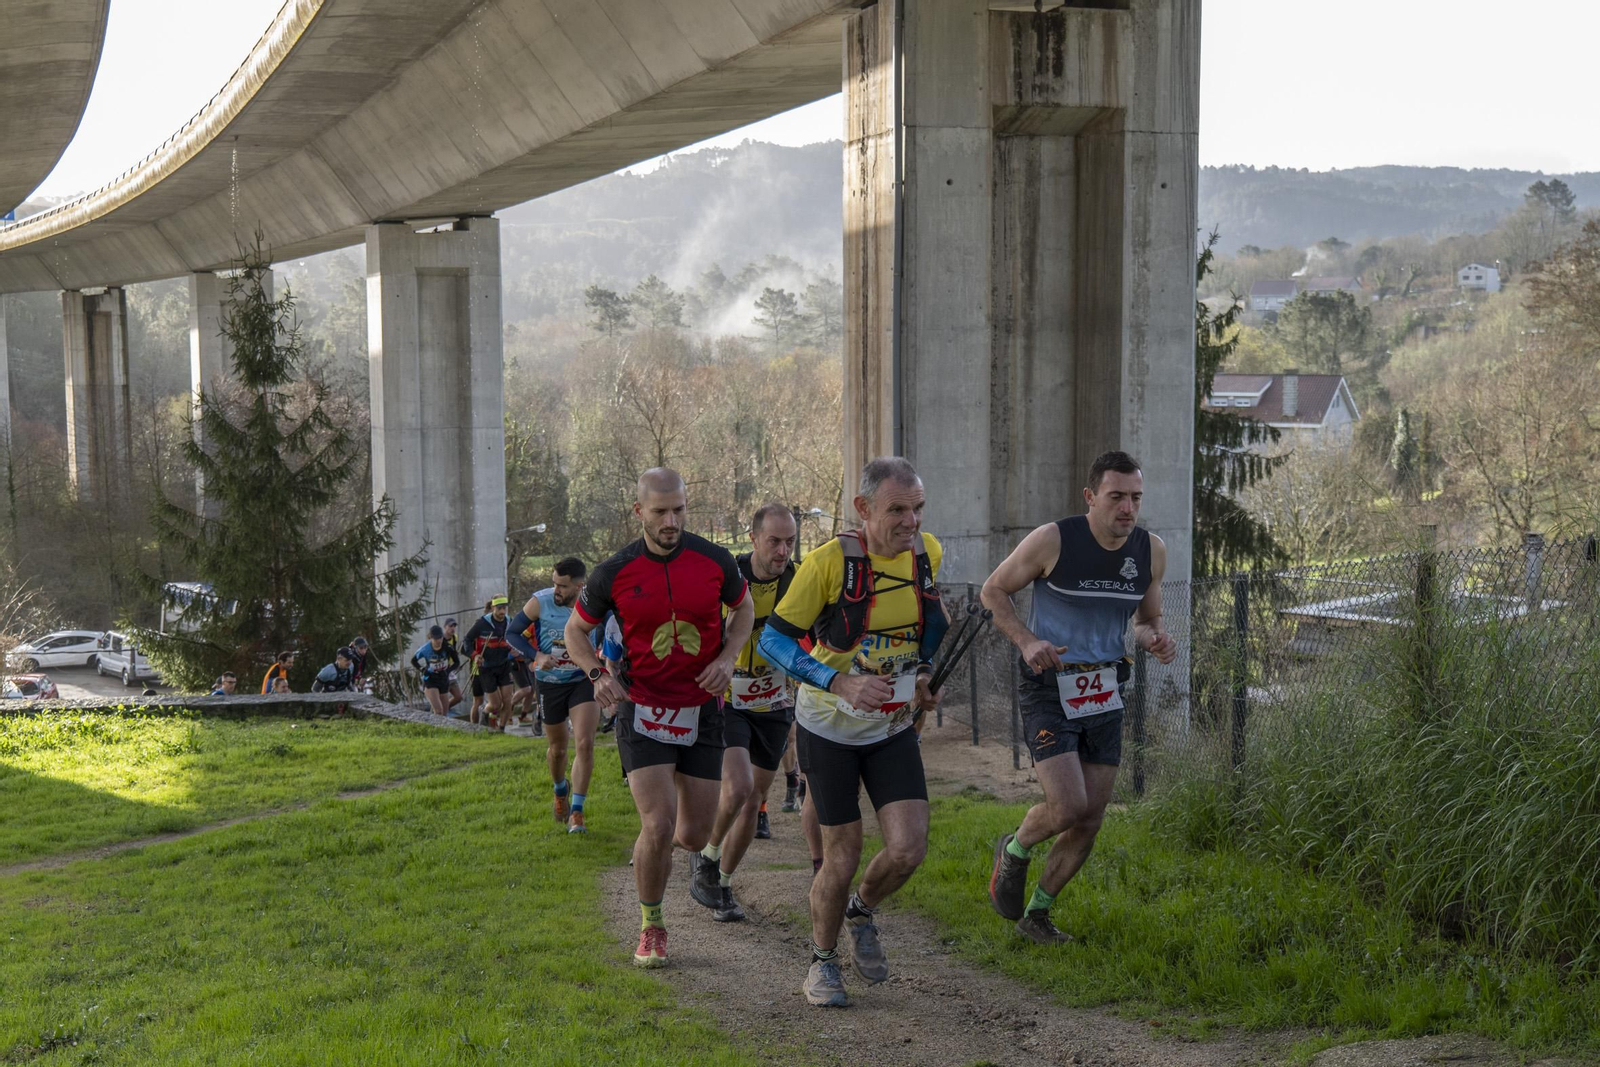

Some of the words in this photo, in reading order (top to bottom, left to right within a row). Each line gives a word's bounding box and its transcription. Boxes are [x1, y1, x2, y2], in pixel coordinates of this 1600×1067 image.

[1078, 580, 1136, 591] XESTEIRAS
[747, 676, 773, 694] 63
[1075, 673, 1104, 696] 94
[651, 705, 681, 725] 97
